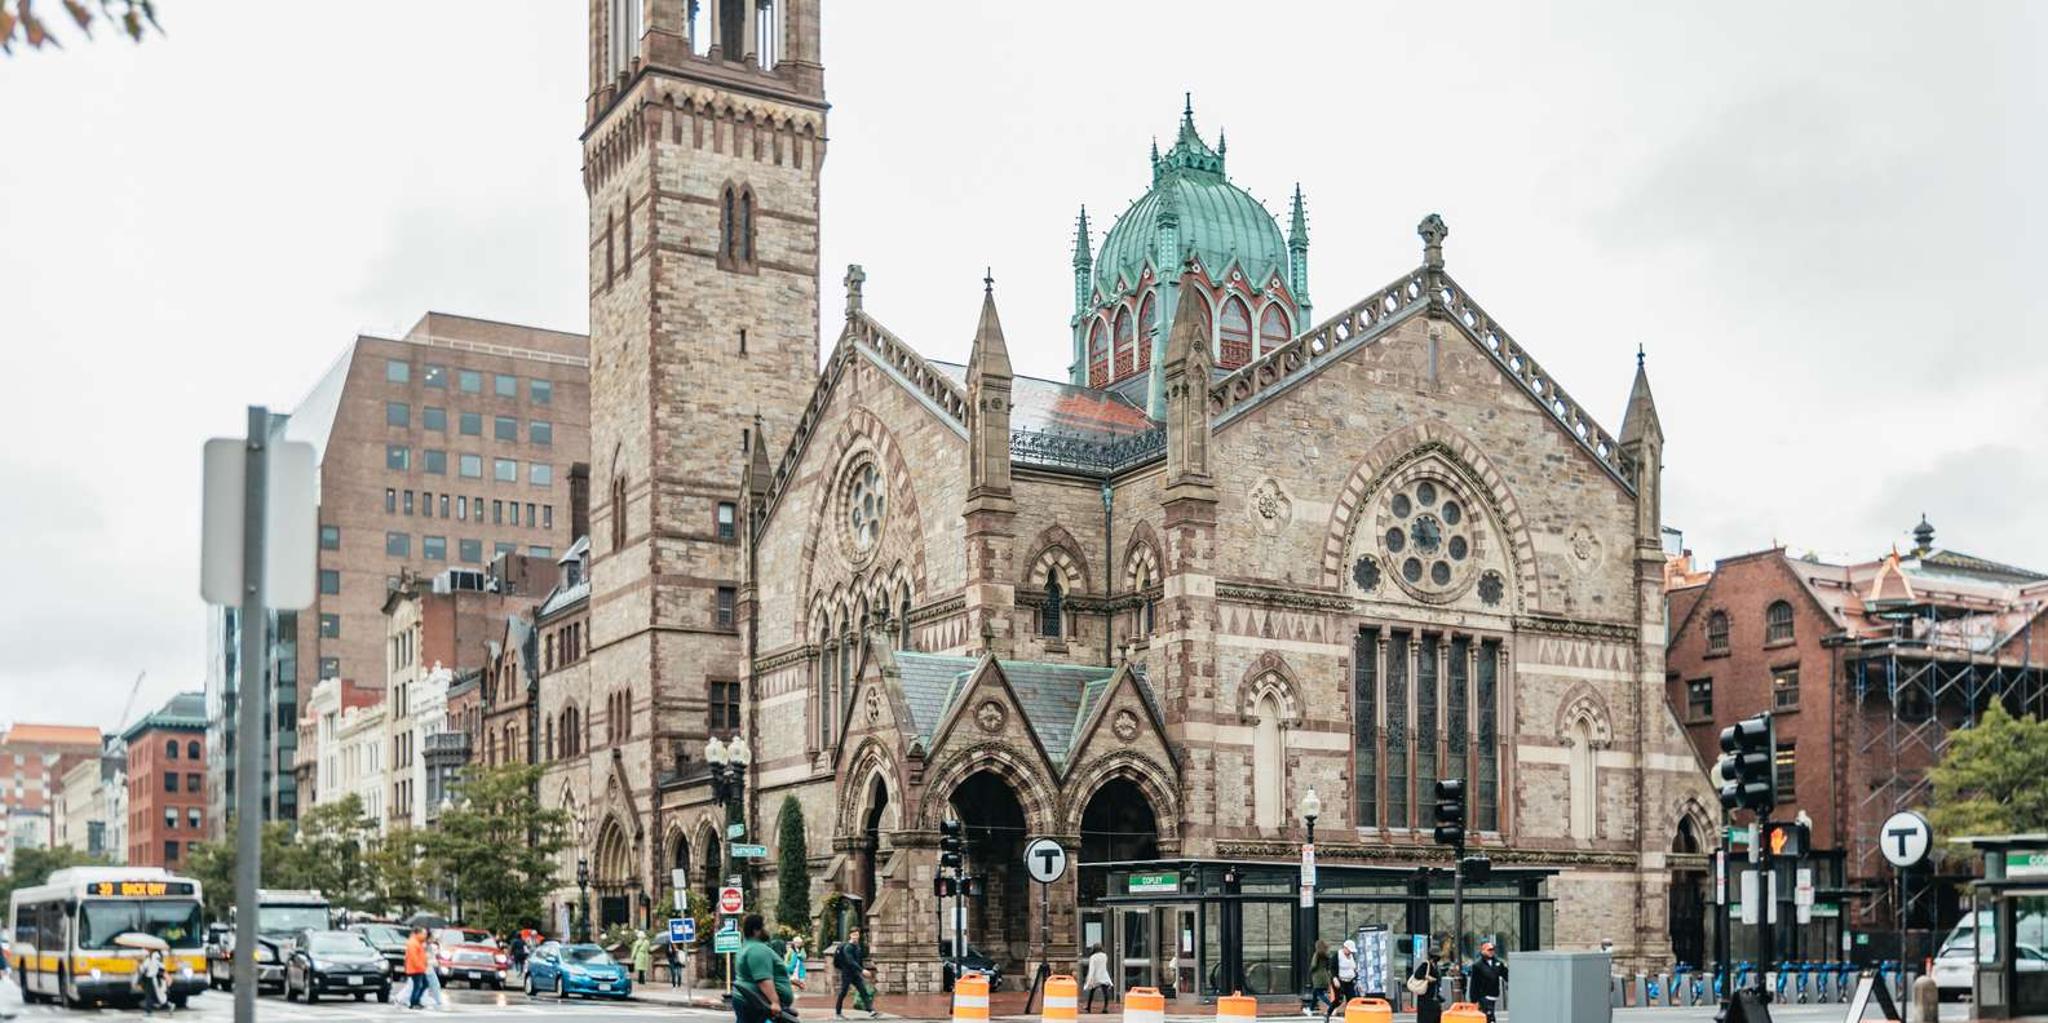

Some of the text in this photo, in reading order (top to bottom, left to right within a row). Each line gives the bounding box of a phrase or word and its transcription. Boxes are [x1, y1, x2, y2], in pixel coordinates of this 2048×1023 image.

[1888, 828, 1917, 857] T
[1034, 849, 1060, 874] T
[2029, 854, 2048, 866] CO
[1142, 876, 1162, 885] COPLEY
[98, 882, 166, 896] 39 BACK BAY
